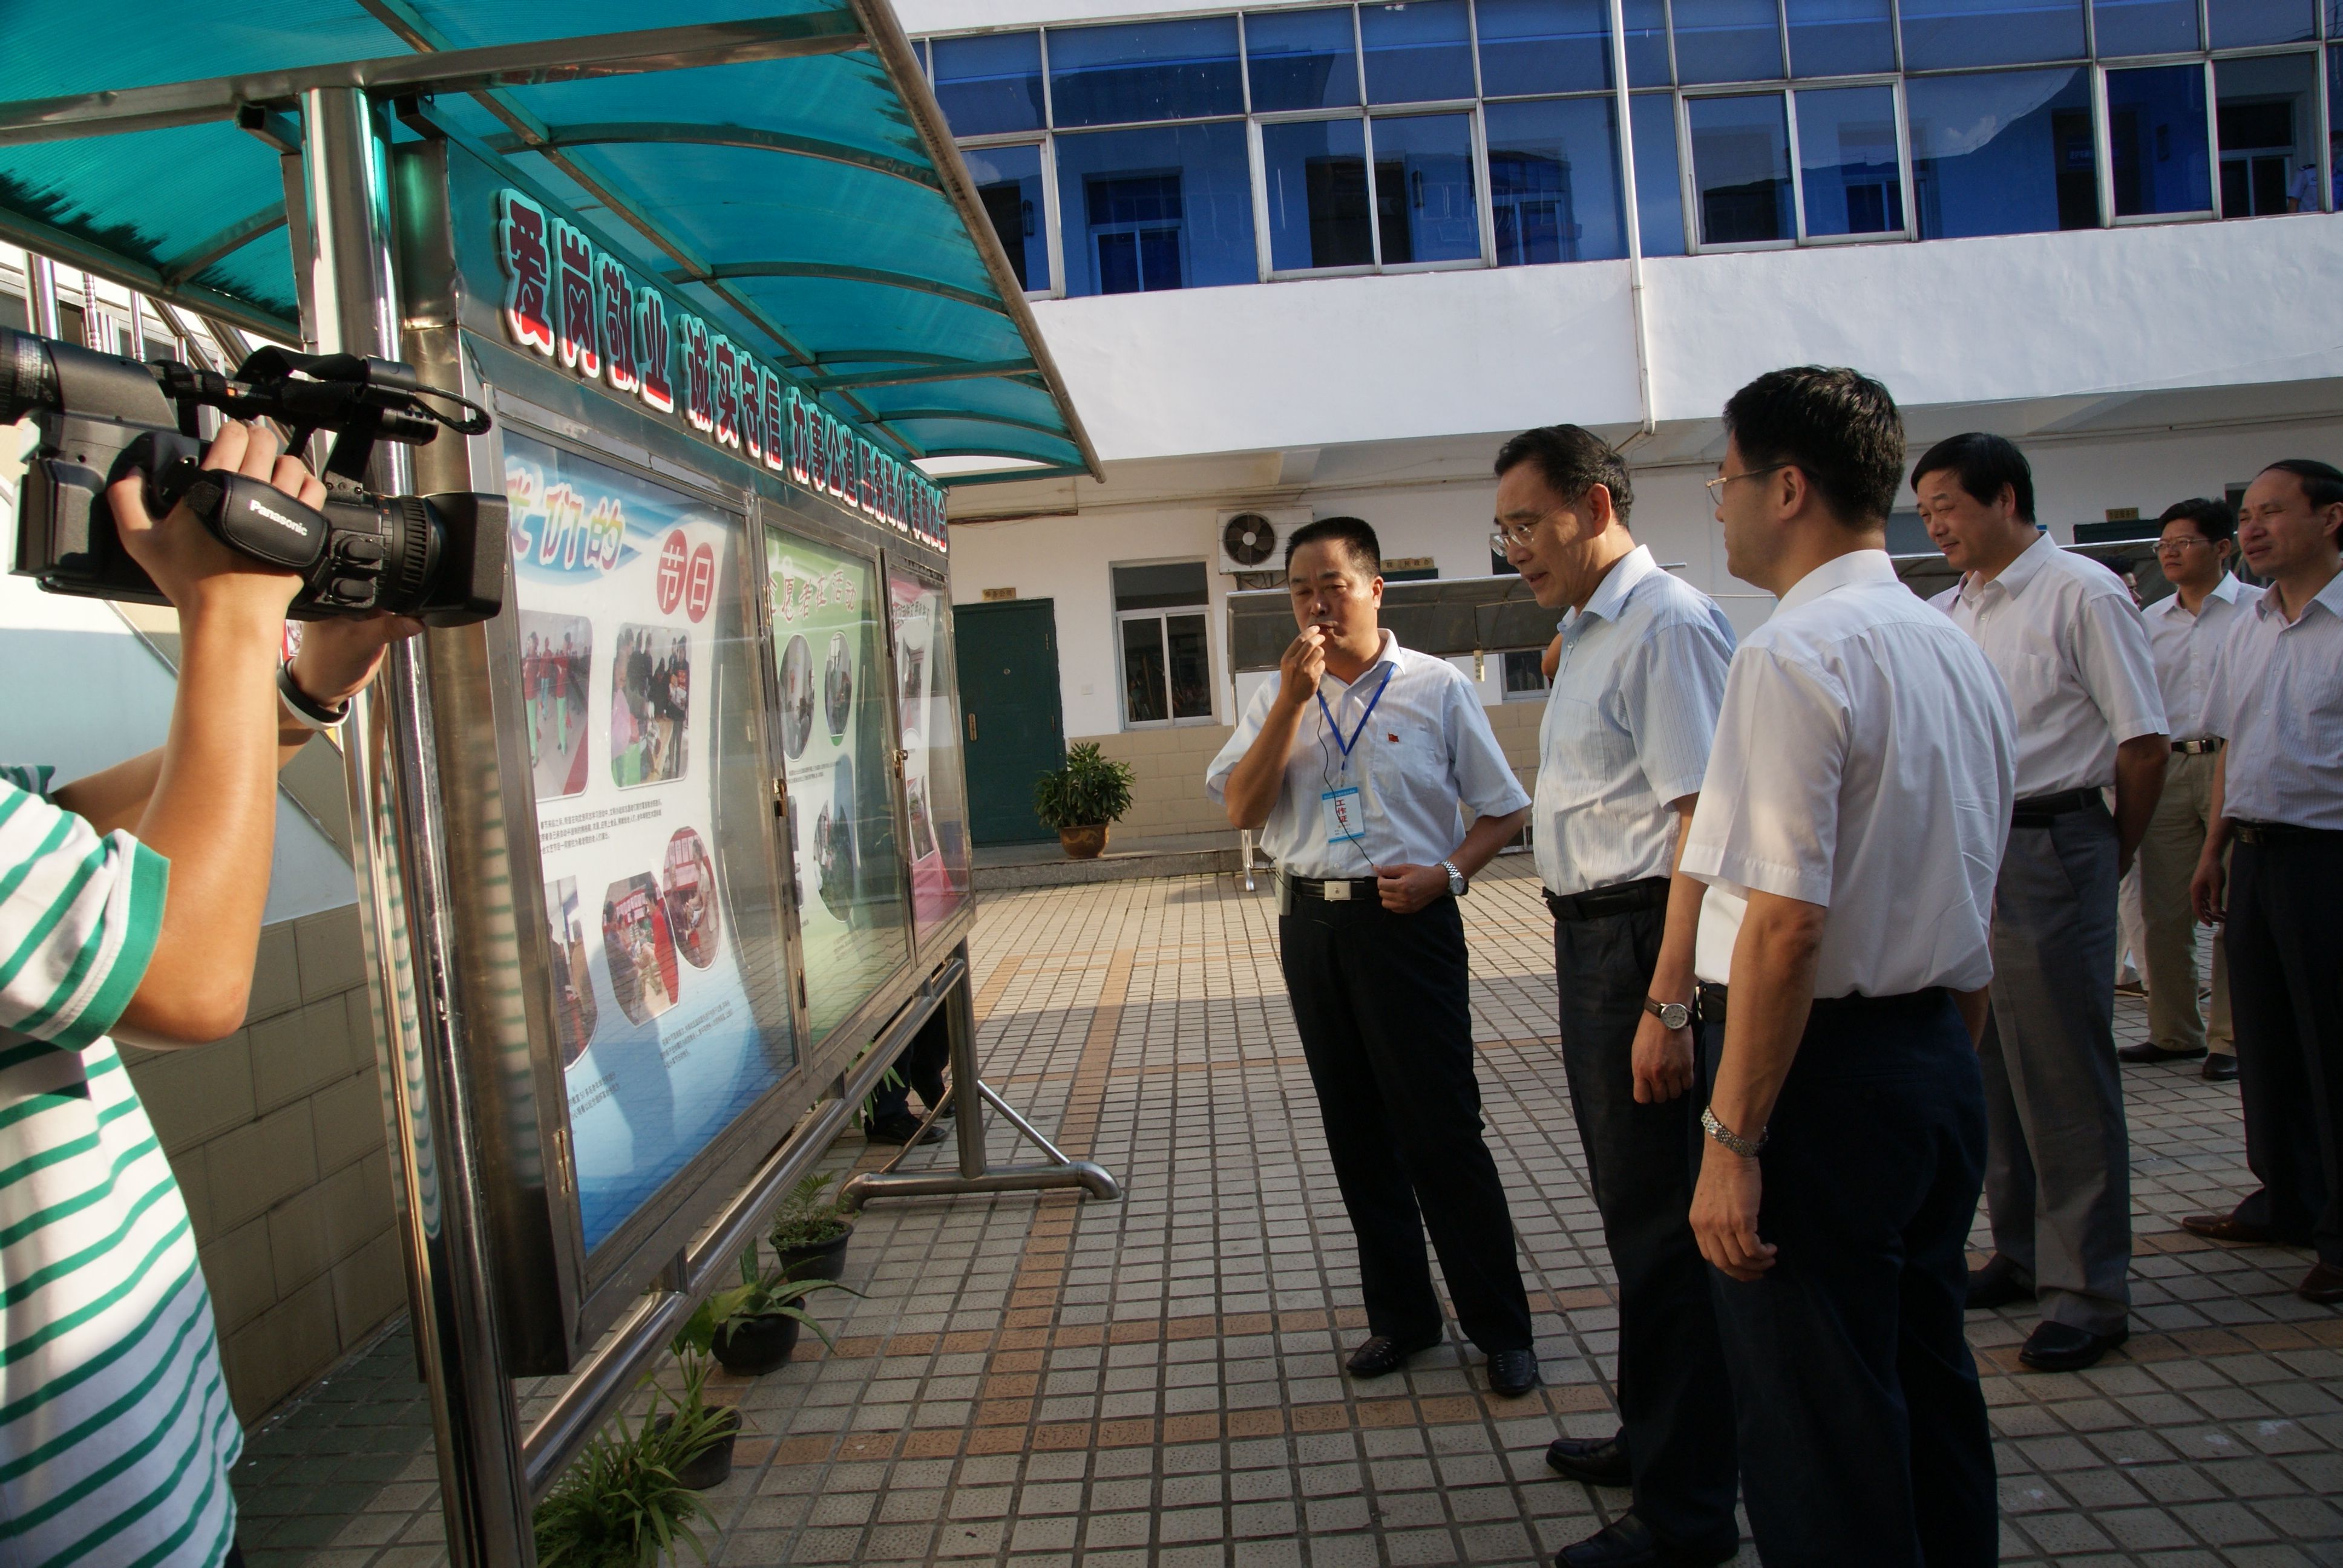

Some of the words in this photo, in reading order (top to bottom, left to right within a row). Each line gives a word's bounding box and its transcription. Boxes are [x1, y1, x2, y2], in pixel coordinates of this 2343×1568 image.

[501, 189, 673, 414] 爱岗敬业
[680, 314, 784, 471] 诚实守信
[788, 387, 858, 508] 办事公道
[857, 438, 908, 532] 服务群众
[250, 500, 307, 536] Panasonic
[660, 545, 712, 612] 节日
